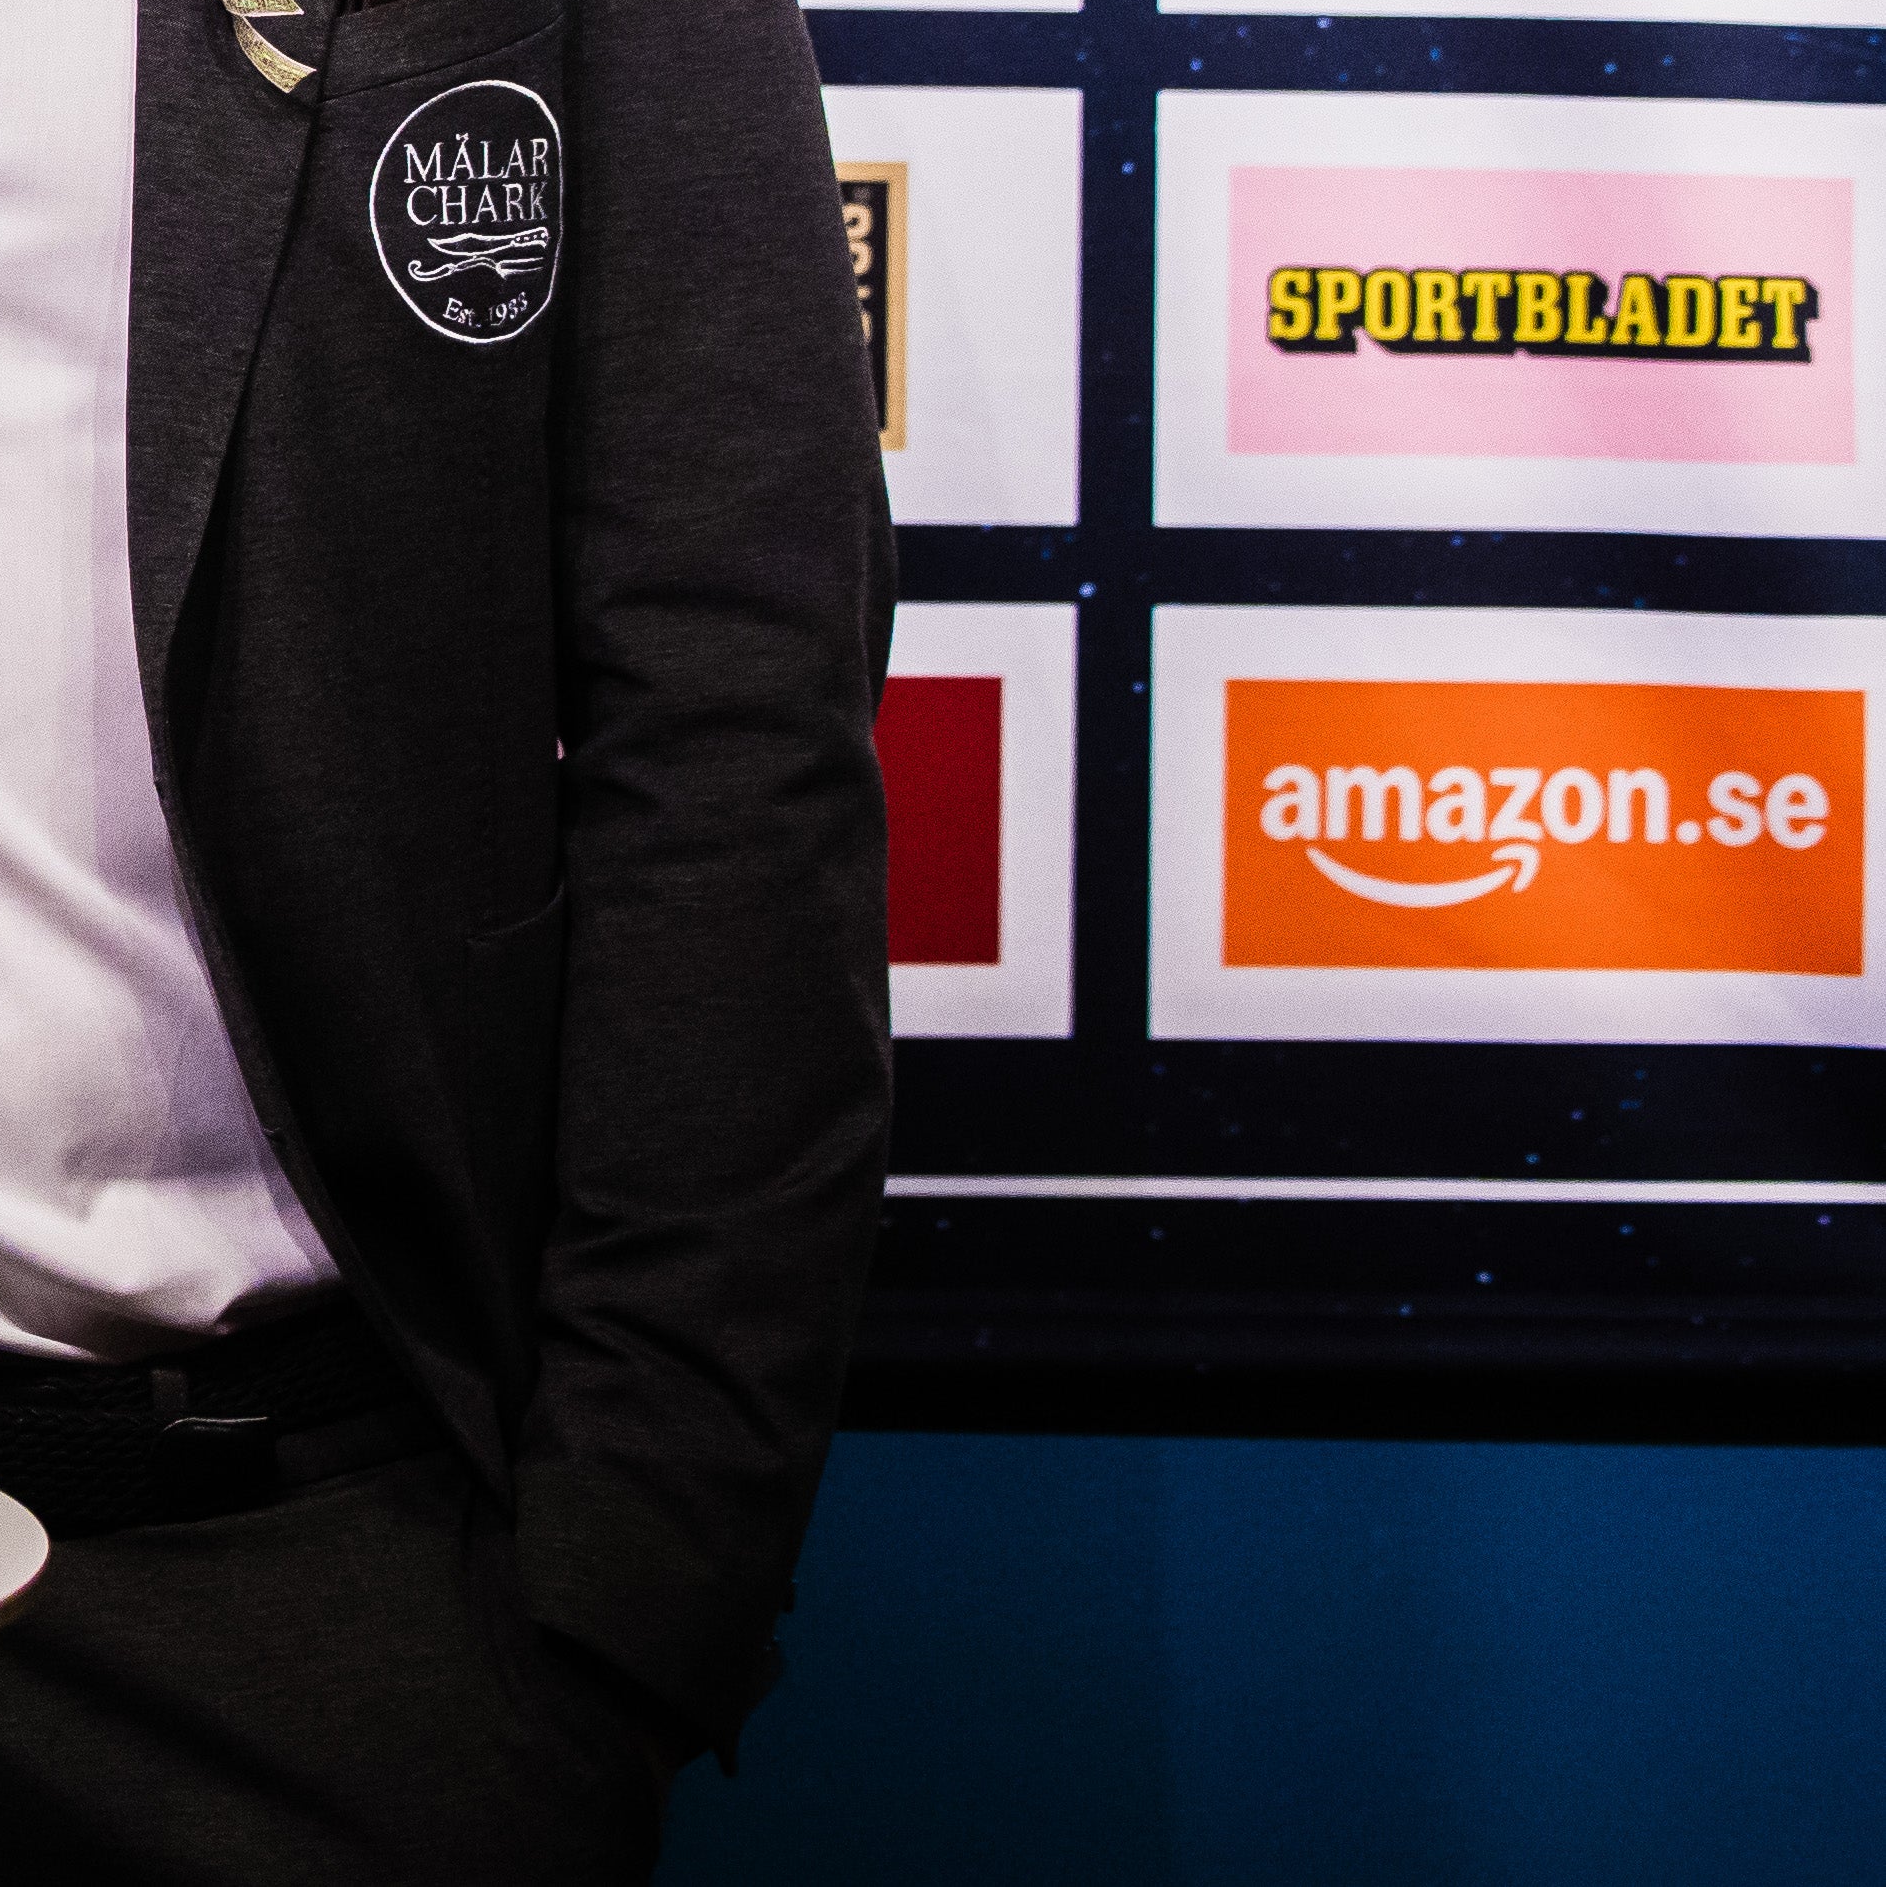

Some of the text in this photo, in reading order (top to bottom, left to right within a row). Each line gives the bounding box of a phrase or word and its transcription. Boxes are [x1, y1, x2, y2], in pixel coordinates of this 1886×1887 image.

[403, 132, 549, 184] MÄLAR
[406, 181, 548, 226] CHARK
[1268, 269, 1805, 349] SPORTBLADET
[1262, 766, 1827, 852] amazon.se
